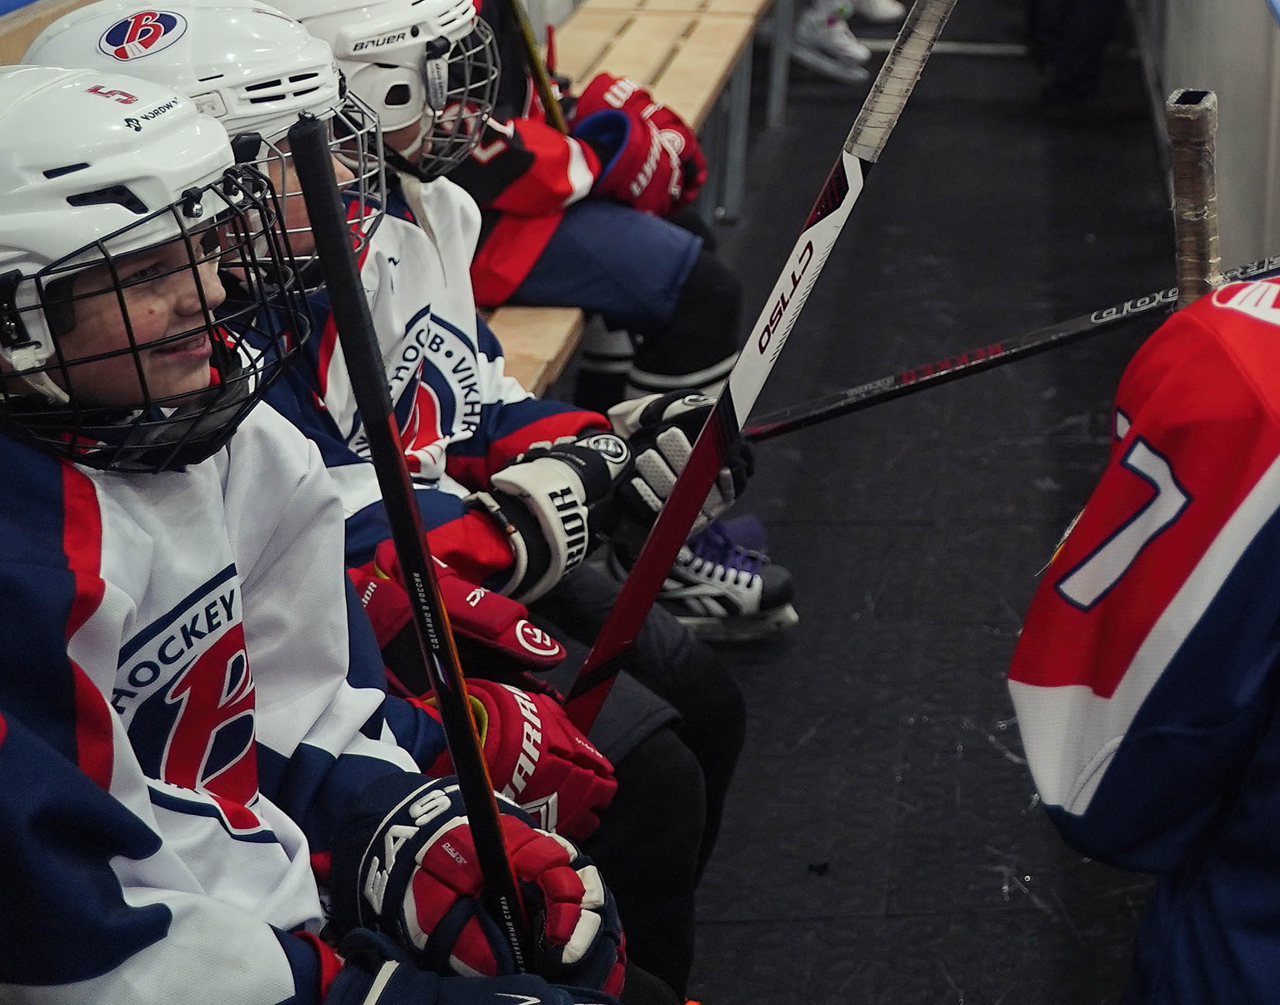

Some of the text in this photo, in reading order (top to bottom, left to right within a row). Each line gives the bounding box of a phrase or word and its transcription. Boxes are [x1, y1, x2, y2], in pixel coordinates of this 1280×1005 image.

[353, 32, 406, 52] BAUER
[548, 486, 586, 577] RIOR
[411, 571, 426, 604] РОССИИ
[424, 611, 441, 650] СДЕЛАНО
[111, 589, 236, 715] HOCKEY
[500, 894, 513, 919] СТИЛЬ
[504, 919, 524, 965] ХОККЕЙНЫЙ
